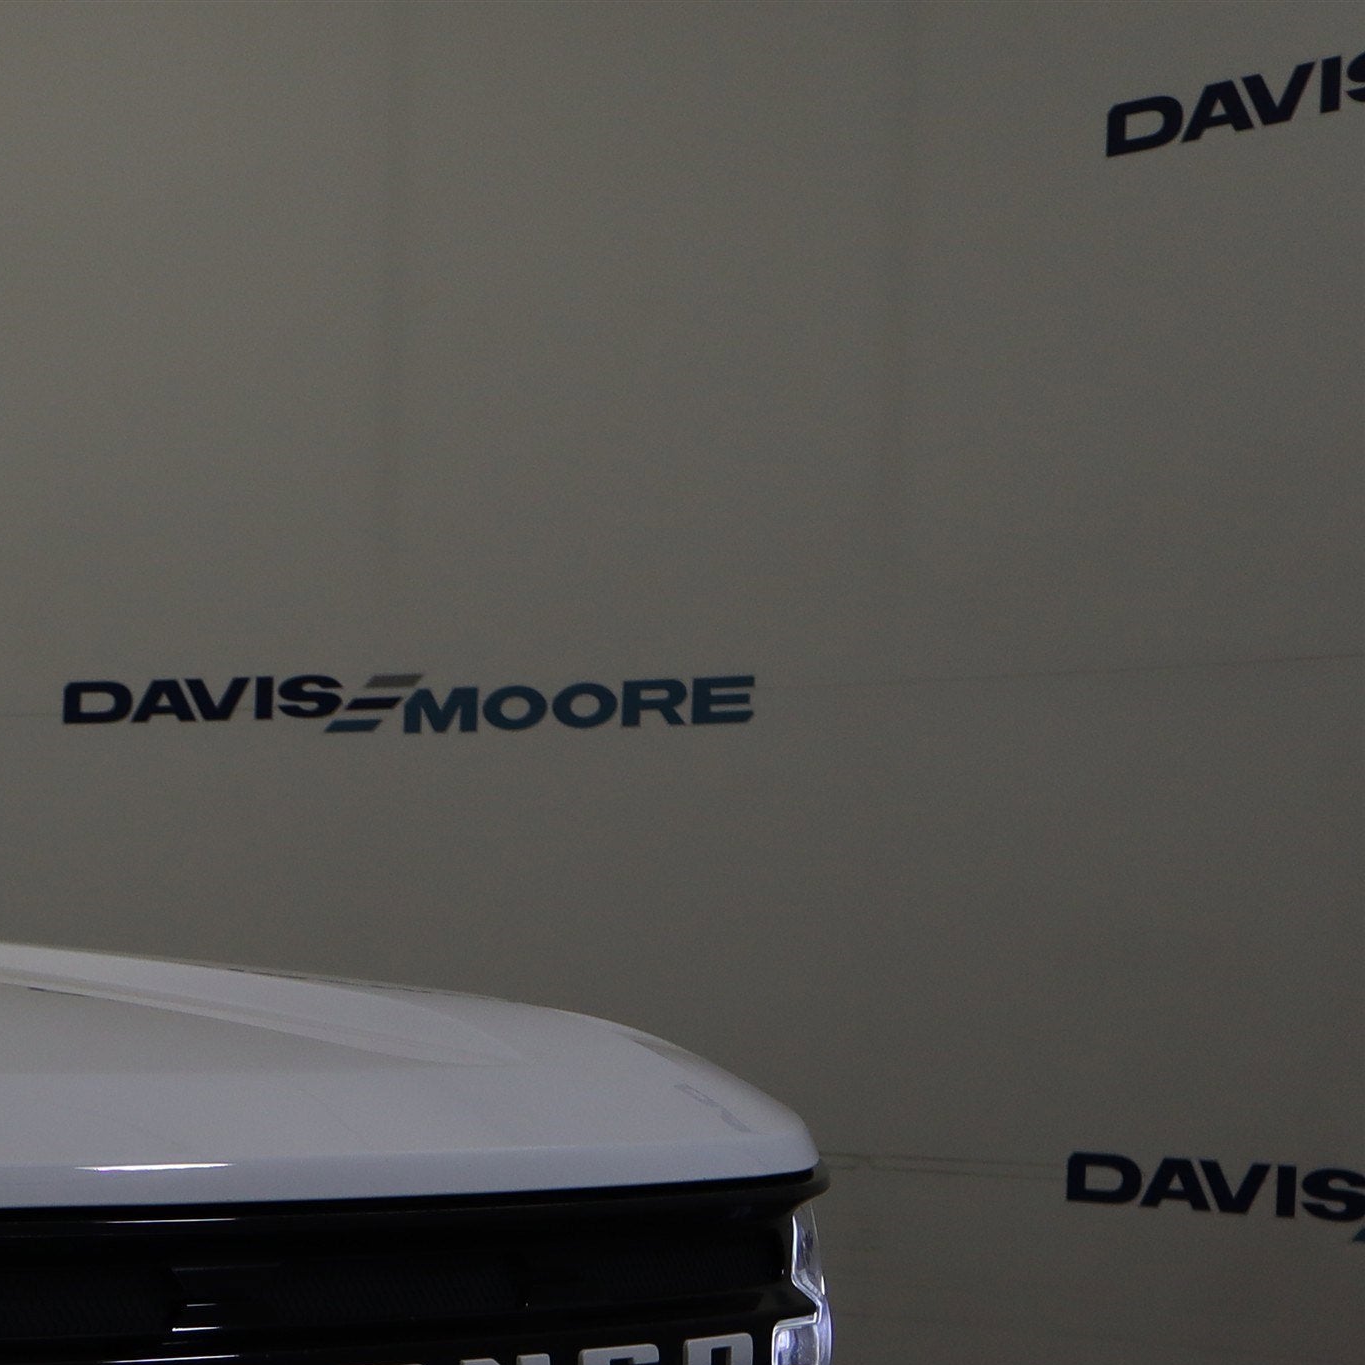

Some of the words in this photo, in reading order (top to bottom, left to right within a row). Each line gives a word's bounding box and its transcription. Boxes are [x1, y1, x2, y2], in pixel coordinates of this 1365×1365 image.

[1106, 53, 1365, 157] DAVI
[63, 675, 343, 724] DAVIS
[403, 675, 756, 734] MOORE
[1066, 1152, 1365, 1222] DAVIS
